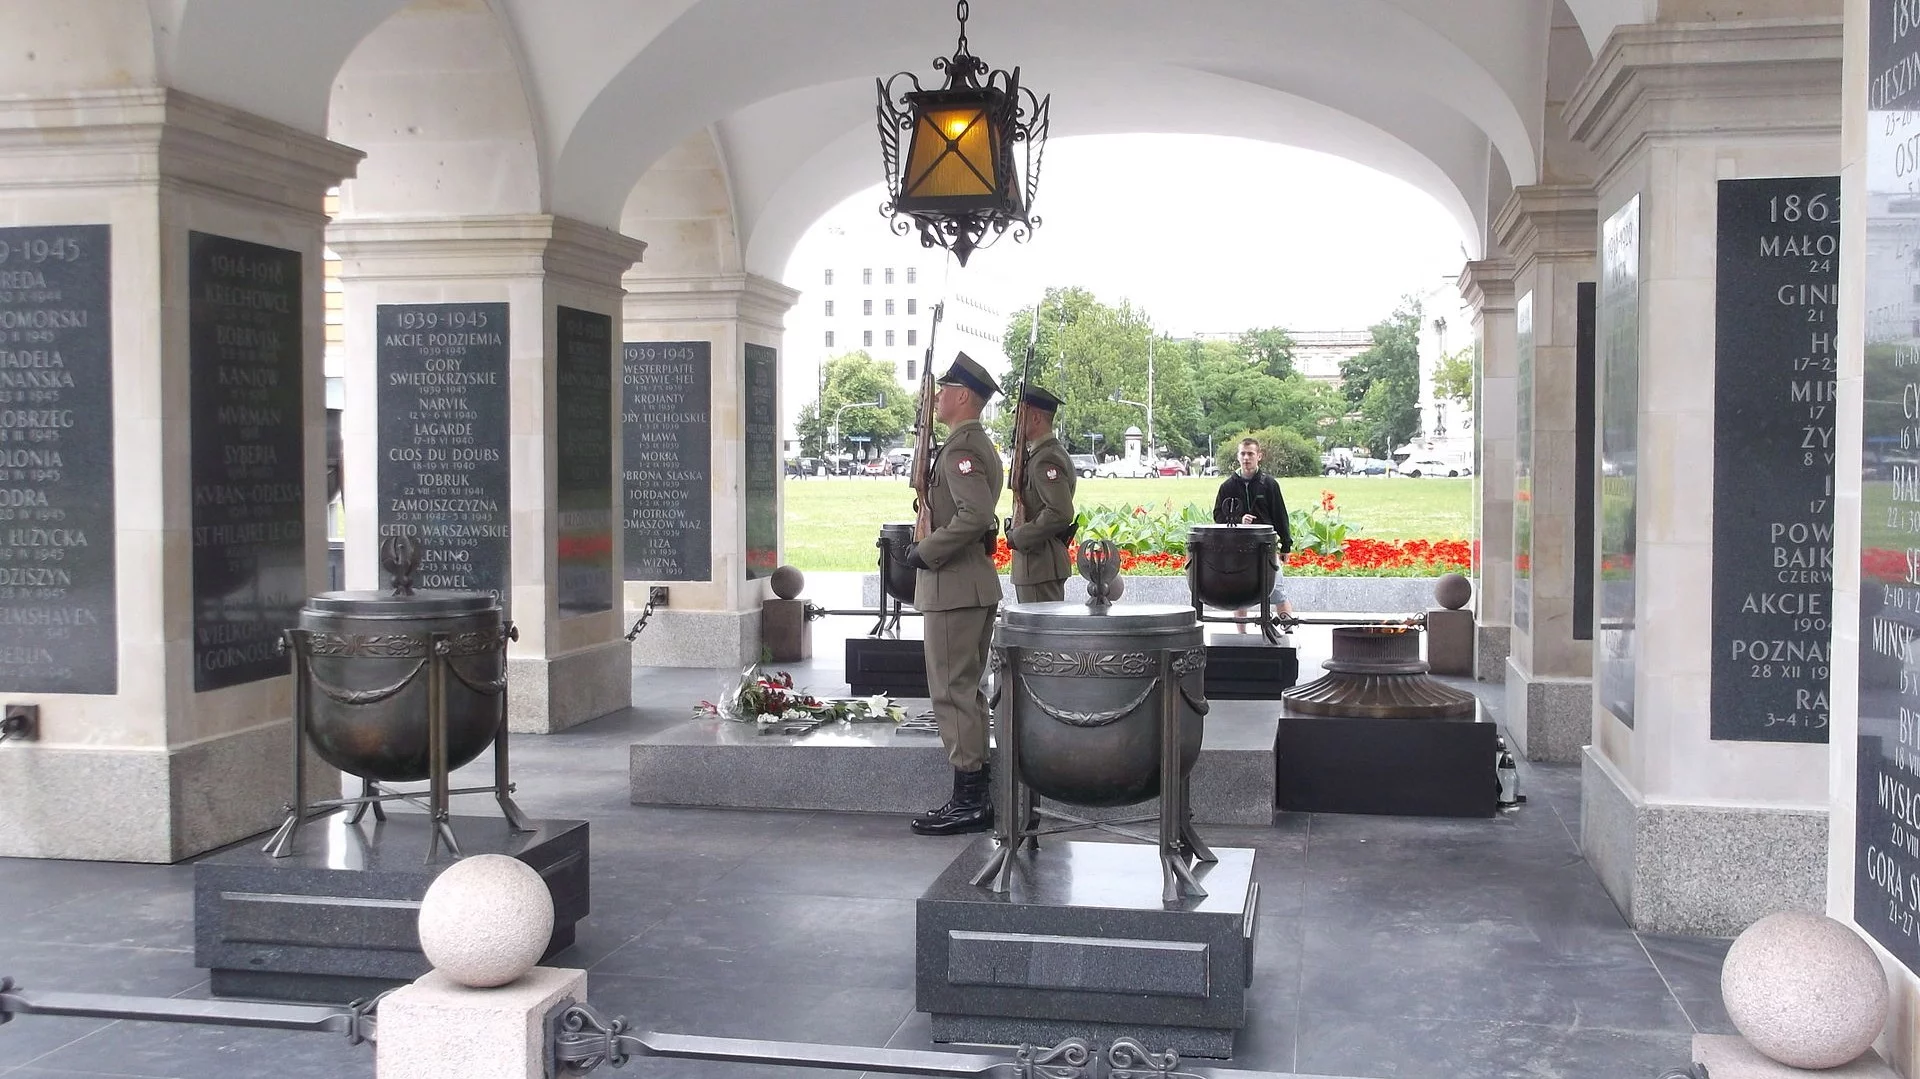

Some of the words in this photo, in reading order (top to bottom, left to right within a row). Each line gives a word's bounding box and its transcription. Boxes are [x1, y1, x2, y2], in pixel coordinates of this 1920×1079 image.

[1760, 235, 1836, 257] MAŁO
[1809, 259, 1831, 273] 24
[0, 310, 88, 328] OMORSKI
[398, 312, 488, 329] 1939-1945
[1807, 309, 1824, 323] 21
[420, 347, 466, 355] 1939-1945
[625, 348, 694, 360] 1939-1945
[420, 386, 466, 395] 1939-1945
[1791, 380, 1837, 402] MIR
[420, 398, 468, 410] NARVIK
[455, 410, 477, 420] 1940
[1809, 406, 1826, 420] 17
[415, 423, 472, 435] LAGARDE
[1801, 424, 1833, 448] ŻY
[1900, 425, 1910, 450] 16
[428, 449, 446, 461] DU
[453, 448, 499, 461] DOUBS
[641, 452, 678, 461] MOKRA
[1803, 452, 1813, 466] 8
[453, 462, 475, 470] 1940
[418, 474, 470, 486] TOBRUK
[392, 499, 498, 512] ZAMOJSZCZYZNA
[1810, 500, 1826, 513] 17
[1887, 507, 1898, 528] 22
[422, 525, 509, 538] WARSZAWSKIE
[1771, 523, 1834, 543] POW
[1774, 547, 1833, 568] BAJK
[423, 575, 468, 588] KOWEL
[1778, 570, 1832, 584] CZERW
[1884, 584, 1904, 608] 2-10
[1741, 593, 1822, 615] AKCJE
[1872, 617, 1914, 665] MIŃSK
[1751, 665, 1772, 678] 28
[1781, 665, 1801, 678] XII
[1811, 666, 1828, 680] 19
[1900, 670, 1909, 694] 15
[1797, 689, 1829, 710] RA
[1764, 713, 1797, 727] 3-4
[1804, 715, 1809, 727] i
[1815, 714, 1828, 728] 5
[1895, 746, 1904, 770] 18
[1891, 822, 1903, 848] 20
[1909, 871, 1920, 913] S
[1888, 900, 1914, 937] 21-27
